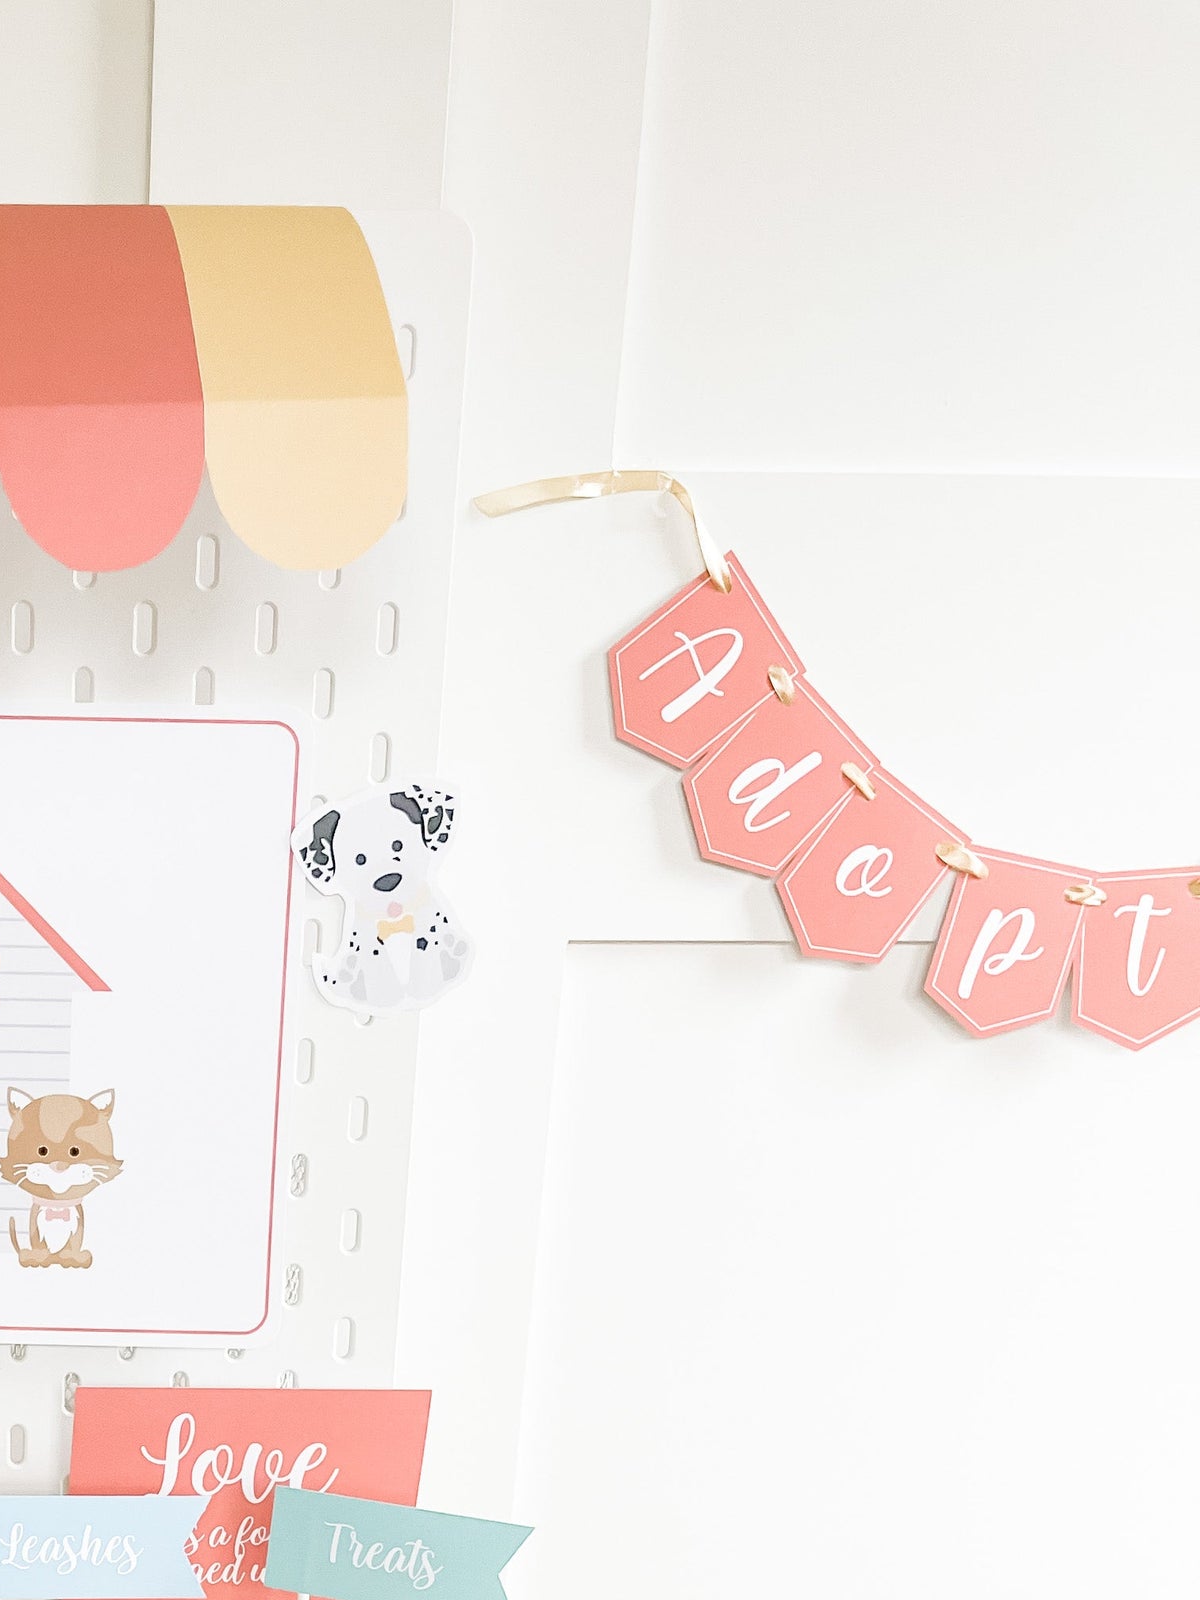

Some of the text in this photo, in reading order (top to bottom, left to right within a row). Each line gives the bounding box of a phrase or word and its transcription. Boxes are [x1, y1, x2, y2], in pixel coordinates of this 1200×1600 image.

[140, 1412, 340, 1504] Love
[0, 1522, 145, 1575] Leashes
[208, 1526, 232, 1548] a
[324, 1521, 445, 1590] Treats
